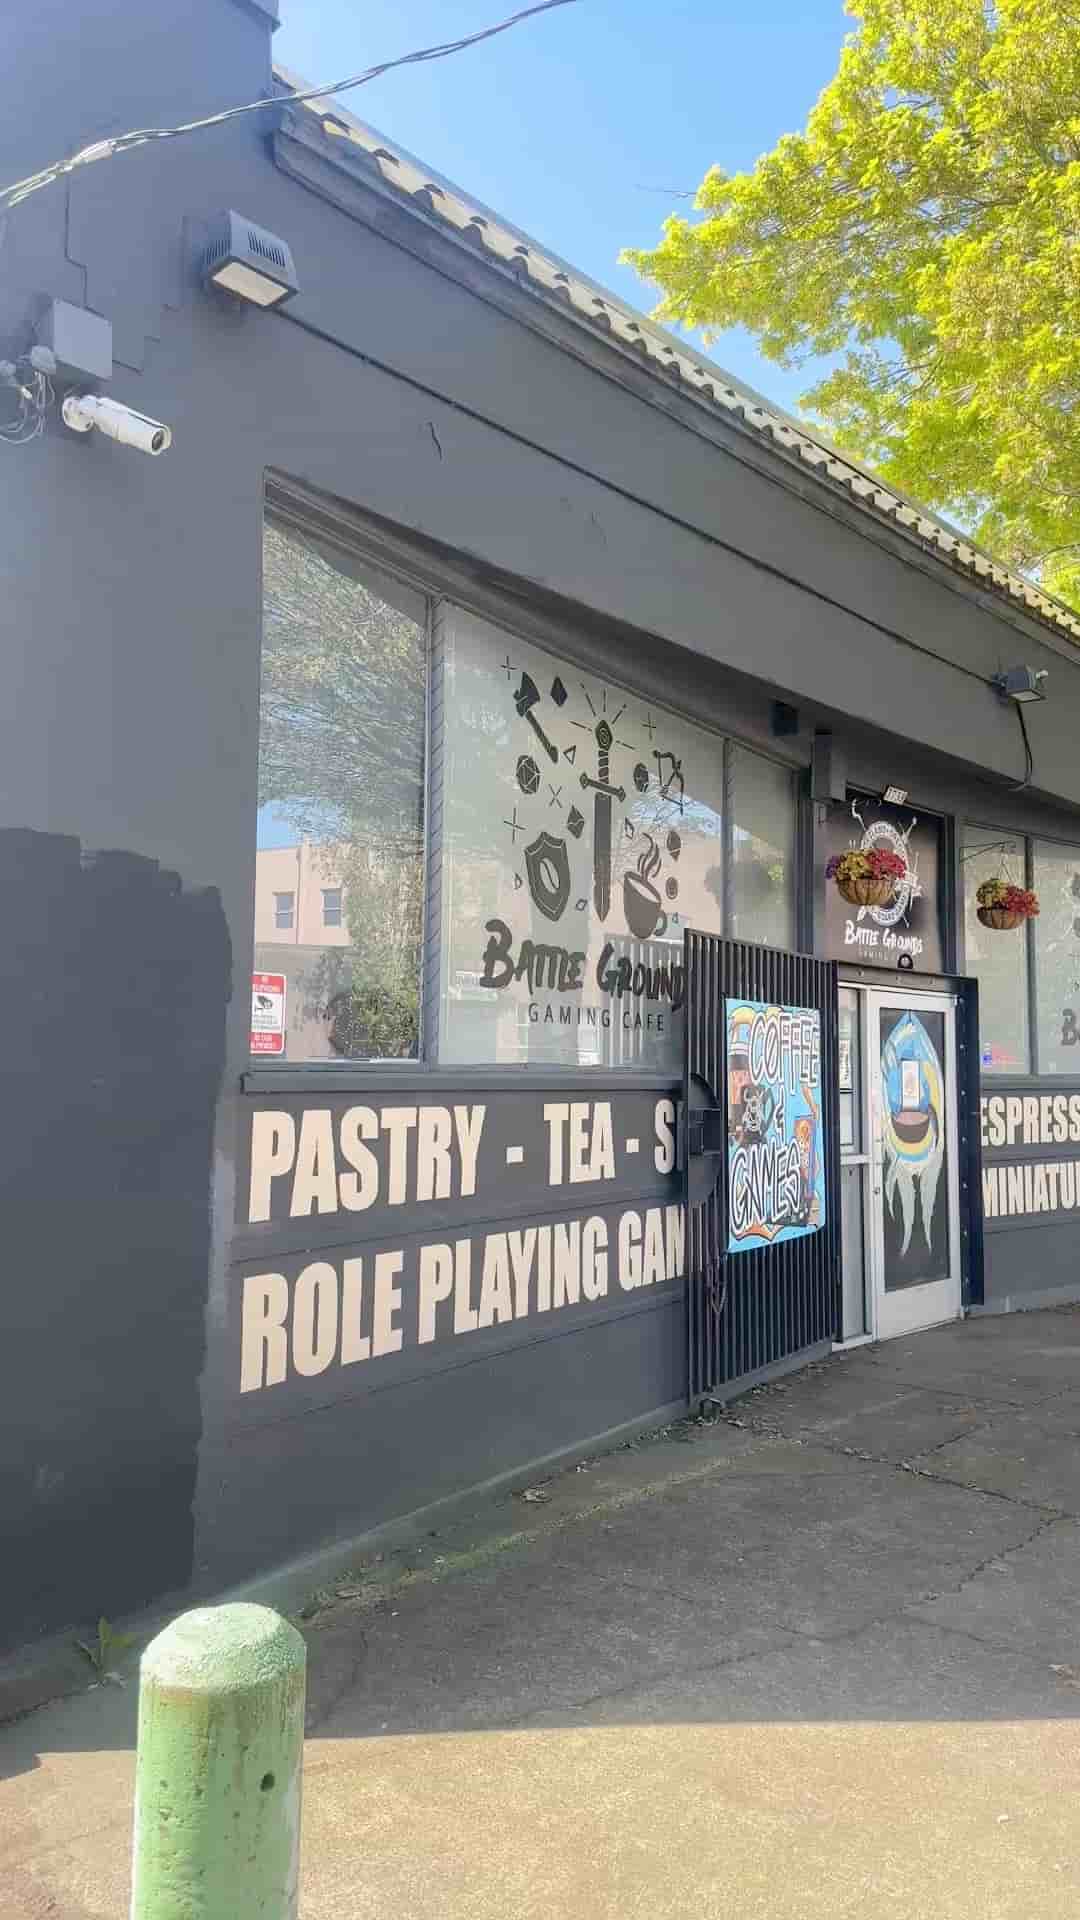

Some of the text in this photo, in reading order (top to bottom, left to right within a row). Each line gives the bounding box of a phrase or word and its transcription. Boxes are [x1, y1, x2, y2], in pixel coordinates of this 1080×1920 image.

[528, 1002, 665, 1032] GAMING CAFE
[749, 1012, 819, 1095] COFFEE
[248, 1105, 486, 1223] PASTRY
[543, 1102, 616, 1186] TEA
[729, 1137, 802, 1234] GAMES
[981, 1161, 1080, 1218] MINIATU
[240, 1250, 404, 1394] ROLE
[418, 1216, 609, 1345] PLAYING
